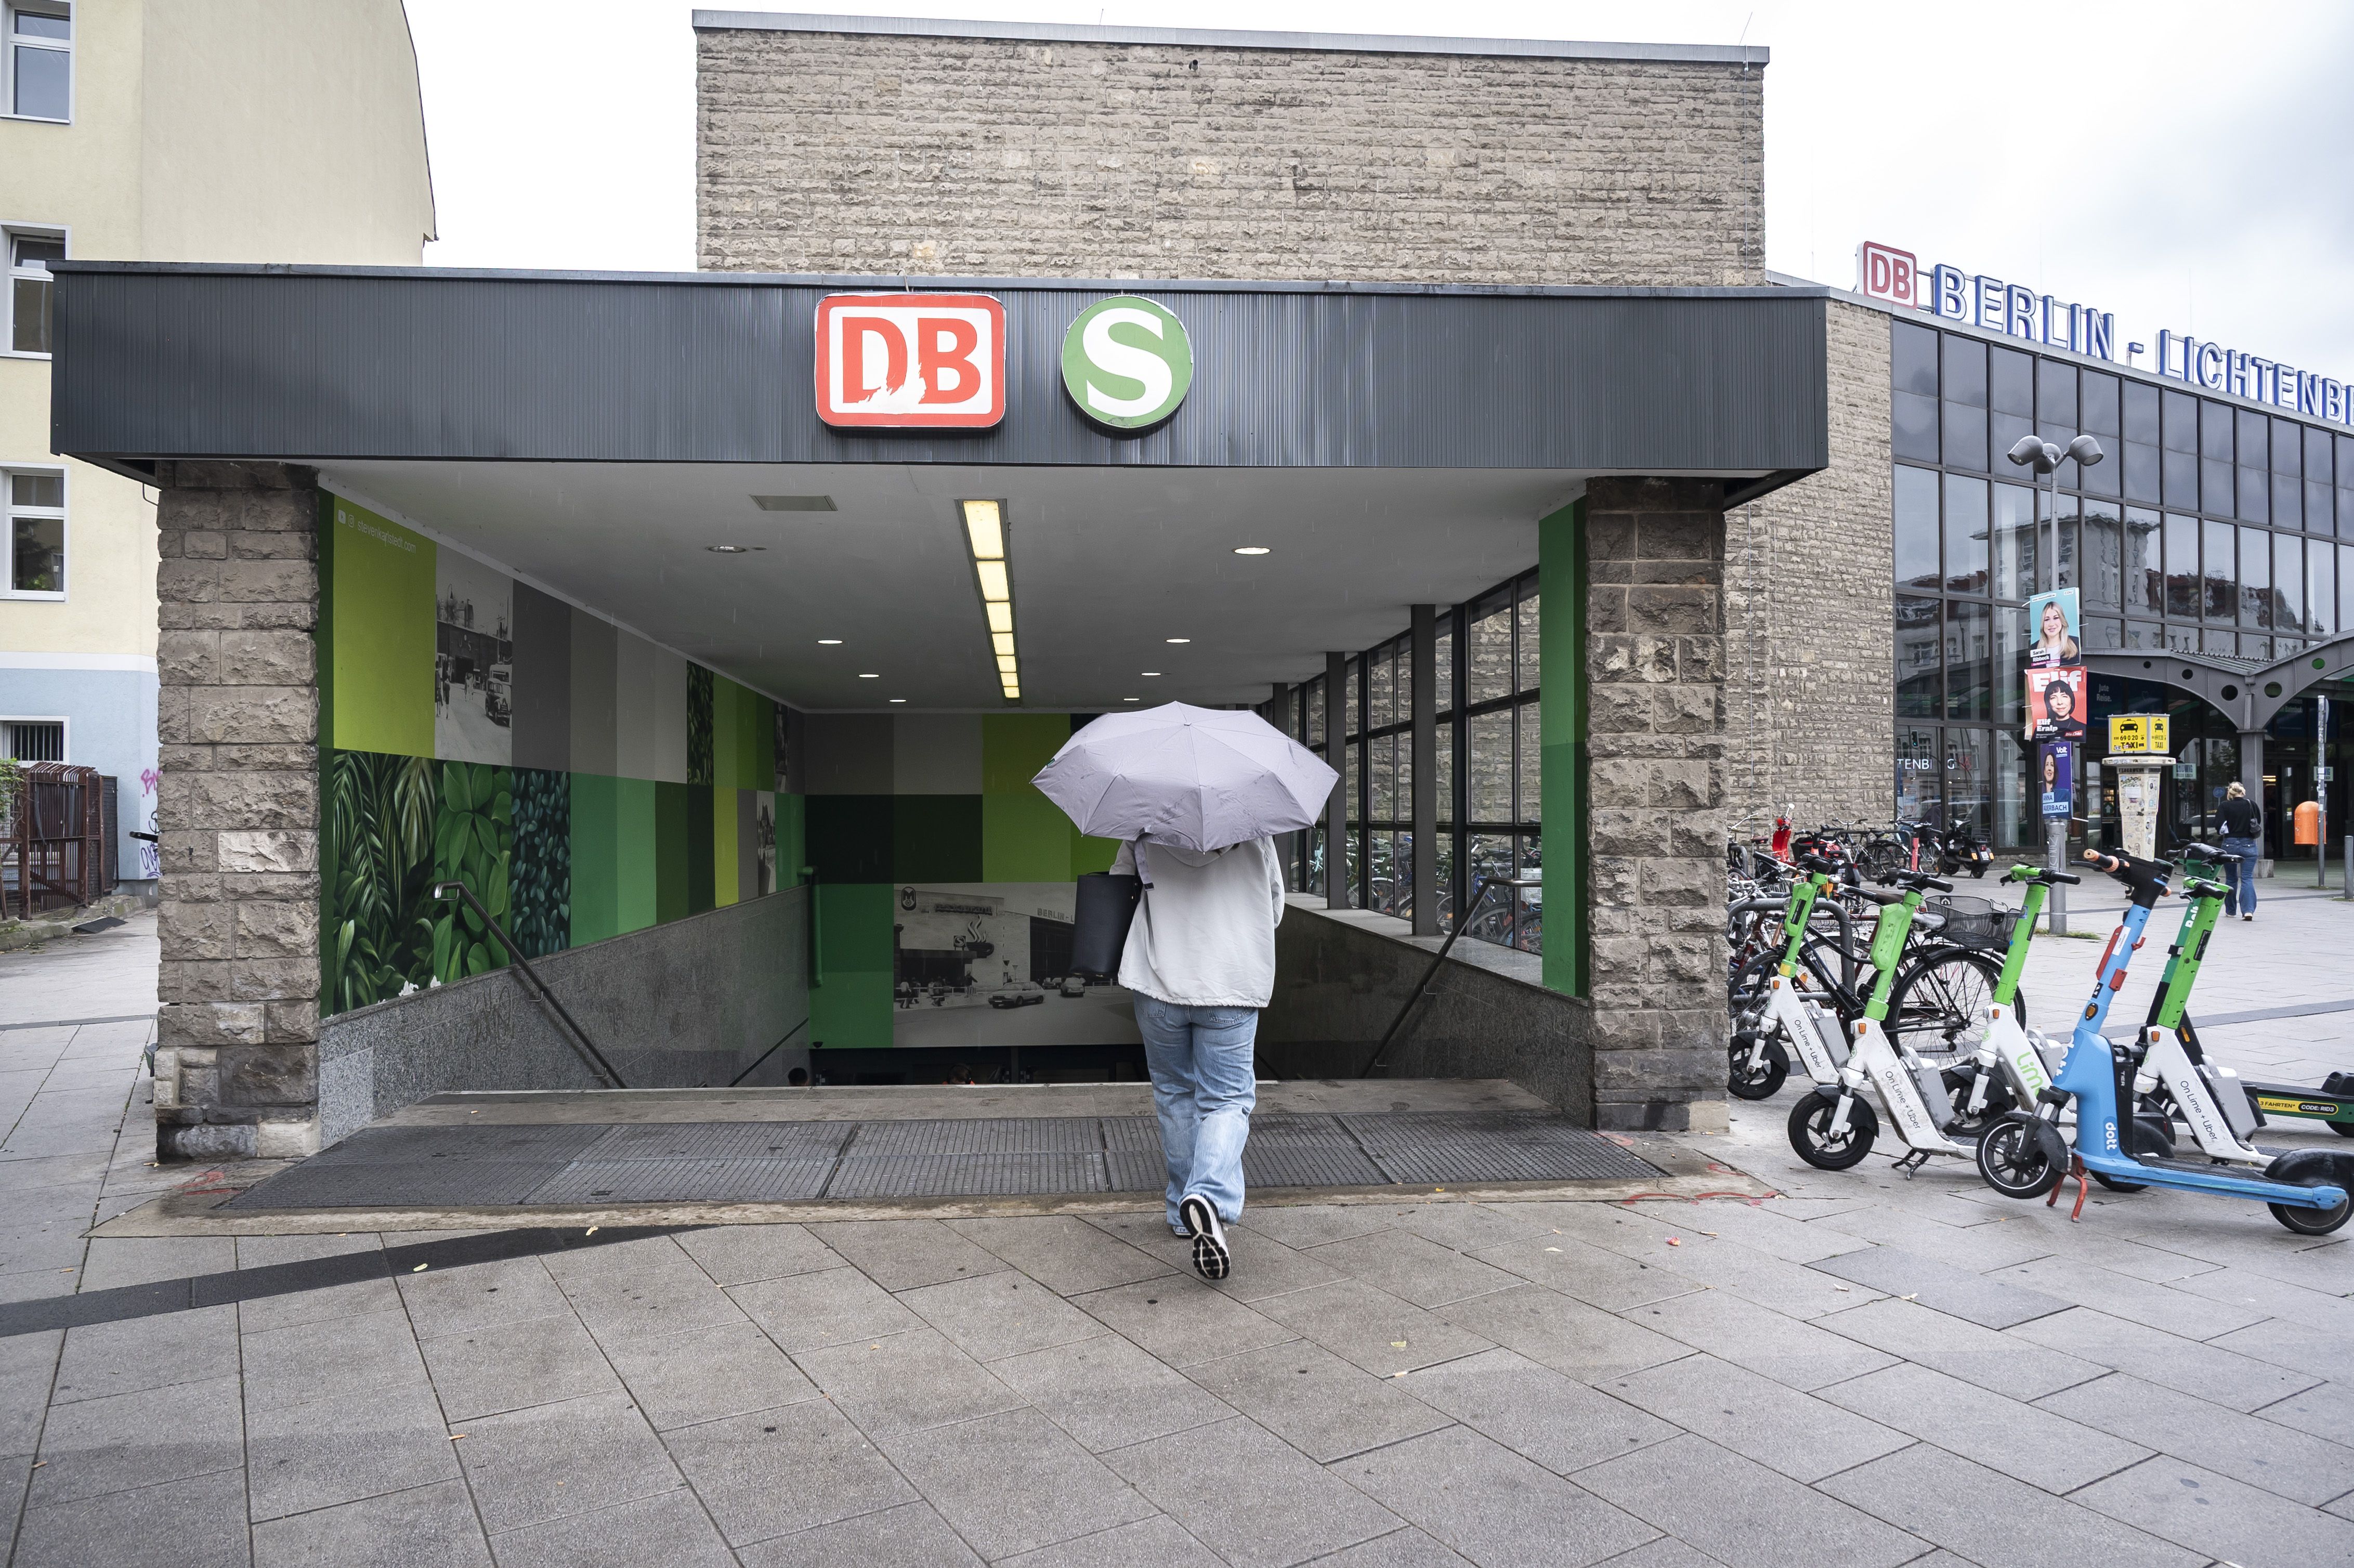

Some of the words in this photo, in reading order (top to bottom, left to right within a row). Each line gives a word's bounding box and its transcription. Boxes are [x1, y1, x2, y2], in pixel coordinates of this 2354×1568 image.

[1872, 253, 1911, 300] DB
[1935, 264, 2113, 362] BERLIN
[842, 317, 981, 404] DB
[1083, 307, 1172, 416] S
[357, 520, 416, 553] stevenkarlstedt.com
[2097, 694, 2112, 702] Reise.
[2099, 684, 2109, 692] Jute
[1897, 759, 1955, 769] TENBG
[1037, 908, 1065, 920] BERLIN
[1795, 1020, 1802, 1029] On
[1799, 1028, 1810, 1047] Lime
[1810, 1050, 1821, 1068] Uber
[1886, 1071, 1894, 1083] On
[1892, 1080, 1906, 1104] Lime
[1907, 1108, 1920, 1130] Uber
[2181, 1080, 2190, 1093] On
[2187, 1093, 2202, 1115] Lime
[2203, 1119, 2218, 1141] Uber
[2105, 1122, 2117, 1150] dott
